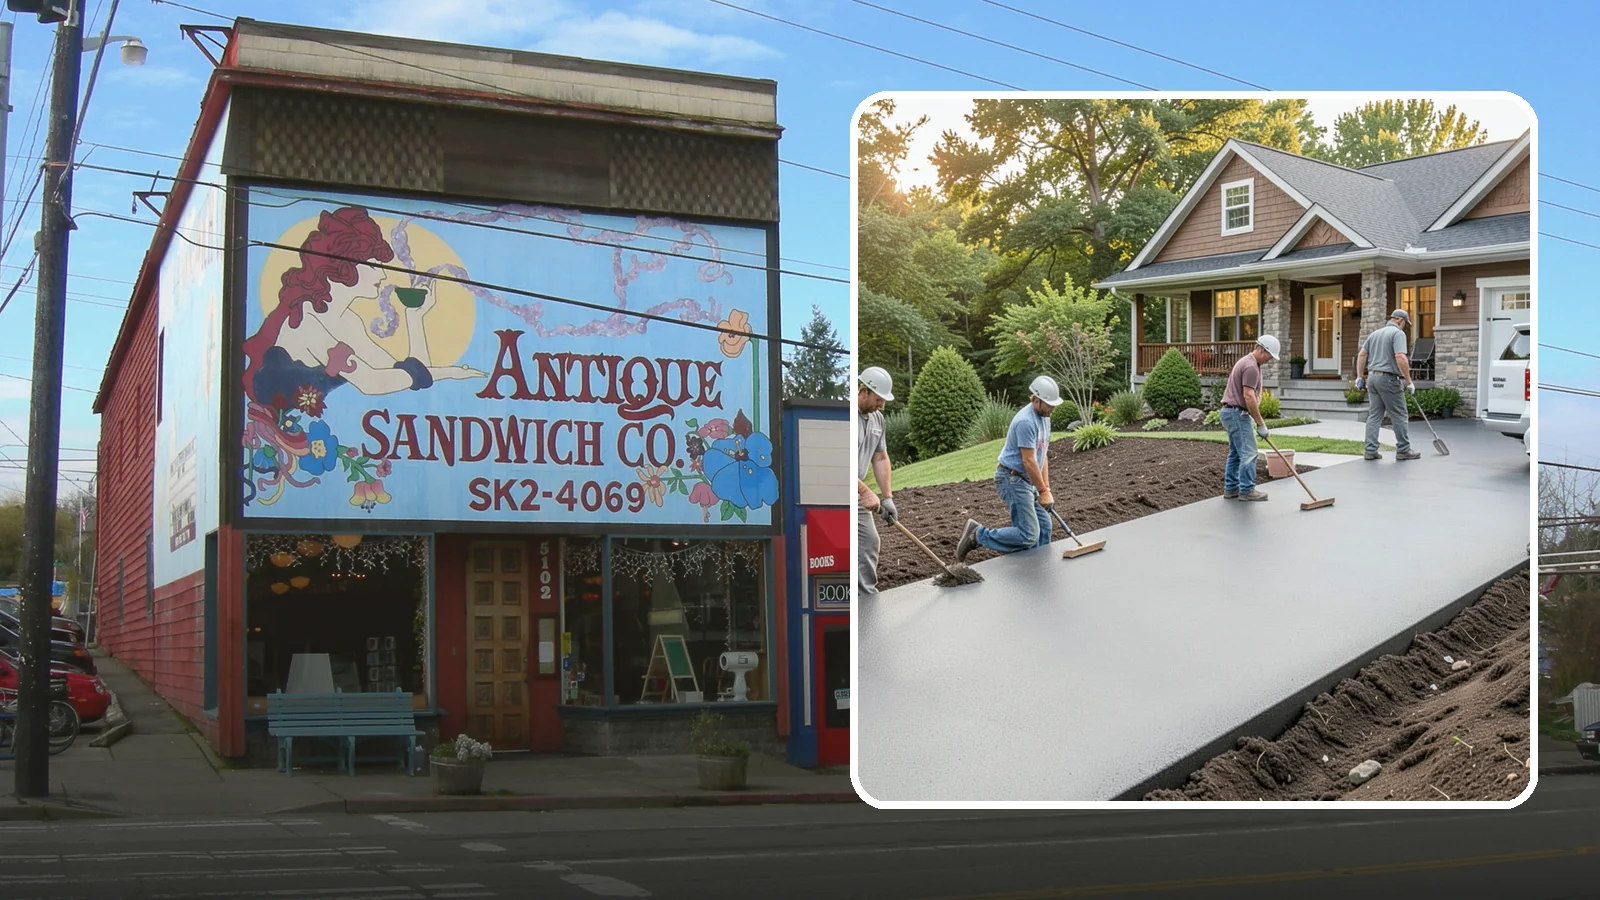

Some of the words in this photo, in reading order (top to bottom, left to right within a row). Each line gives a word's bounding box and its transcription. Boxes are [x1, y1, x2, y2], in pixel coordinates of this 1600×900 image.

[475, 329, 723, 420] ANTIQUE
[362, 408, 604, 467] SANDWICH
[617, 422, 685, 469] CO.
[469, 477, 645, 513] SK2-4069
[540, 541, 551, 600] 5102
[809, 555, 835, 569] BOOKS
